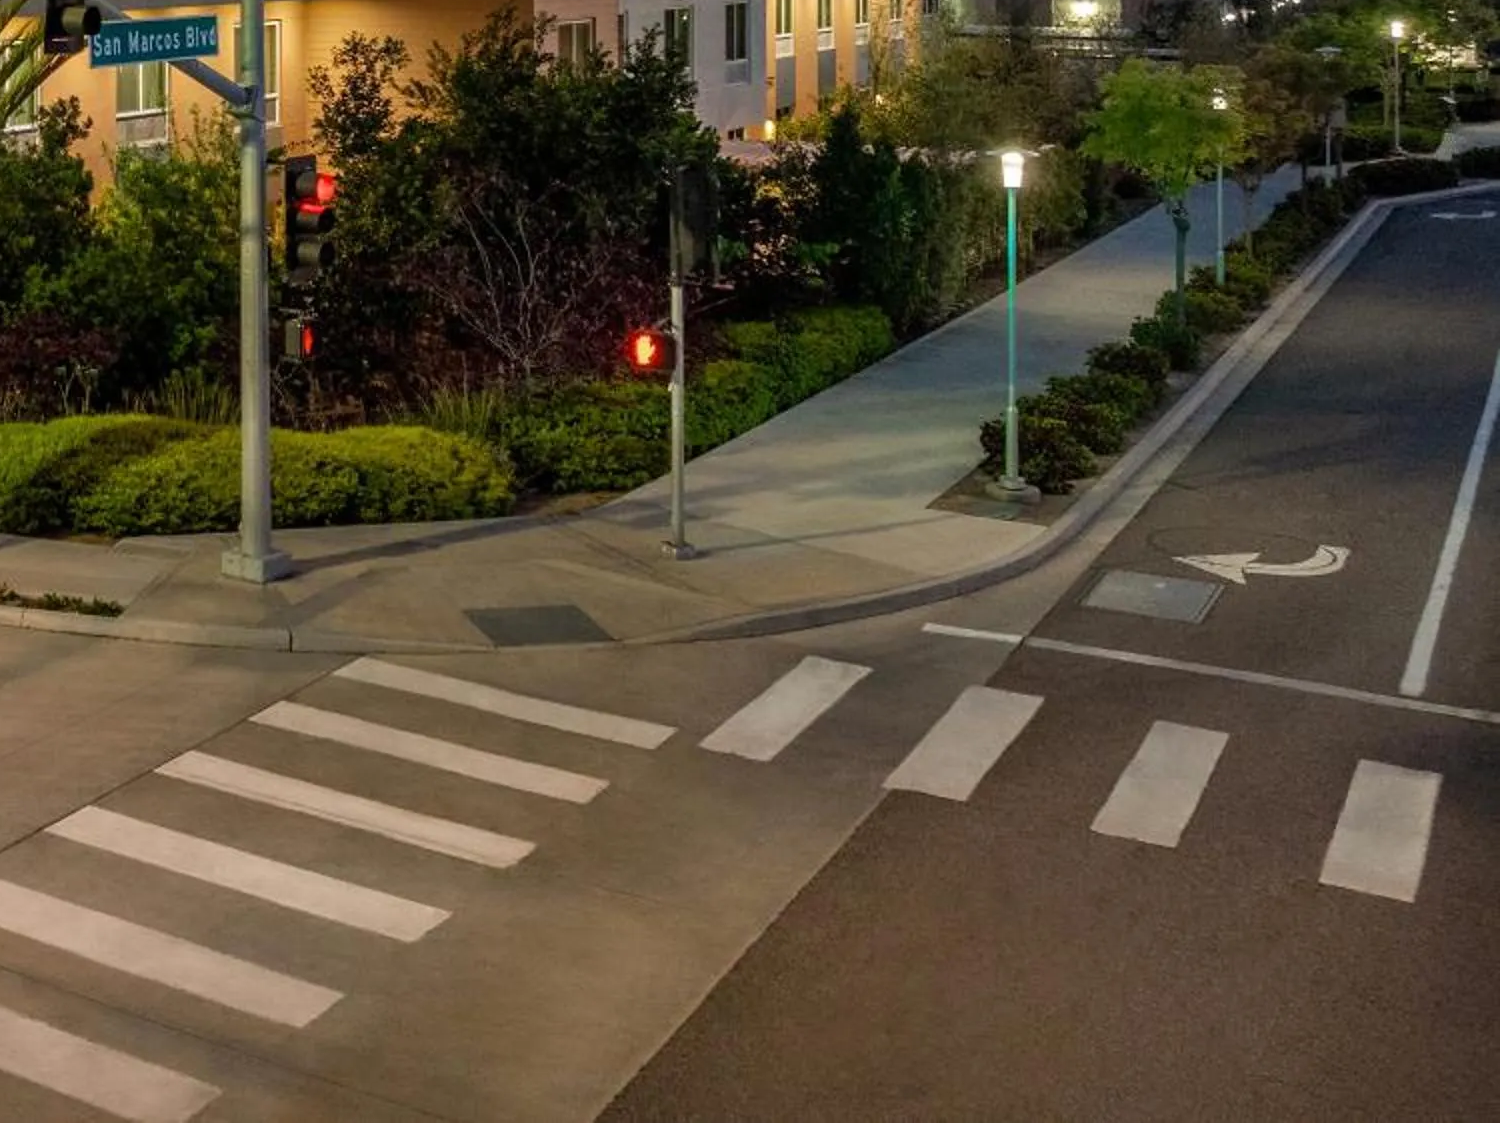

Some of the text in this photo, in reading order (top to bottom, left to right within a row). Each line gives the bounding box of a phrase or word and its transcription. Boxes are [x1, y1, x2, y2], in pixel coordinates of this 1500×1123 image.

[93, 26, 217, 57] San Marcos Blvd
